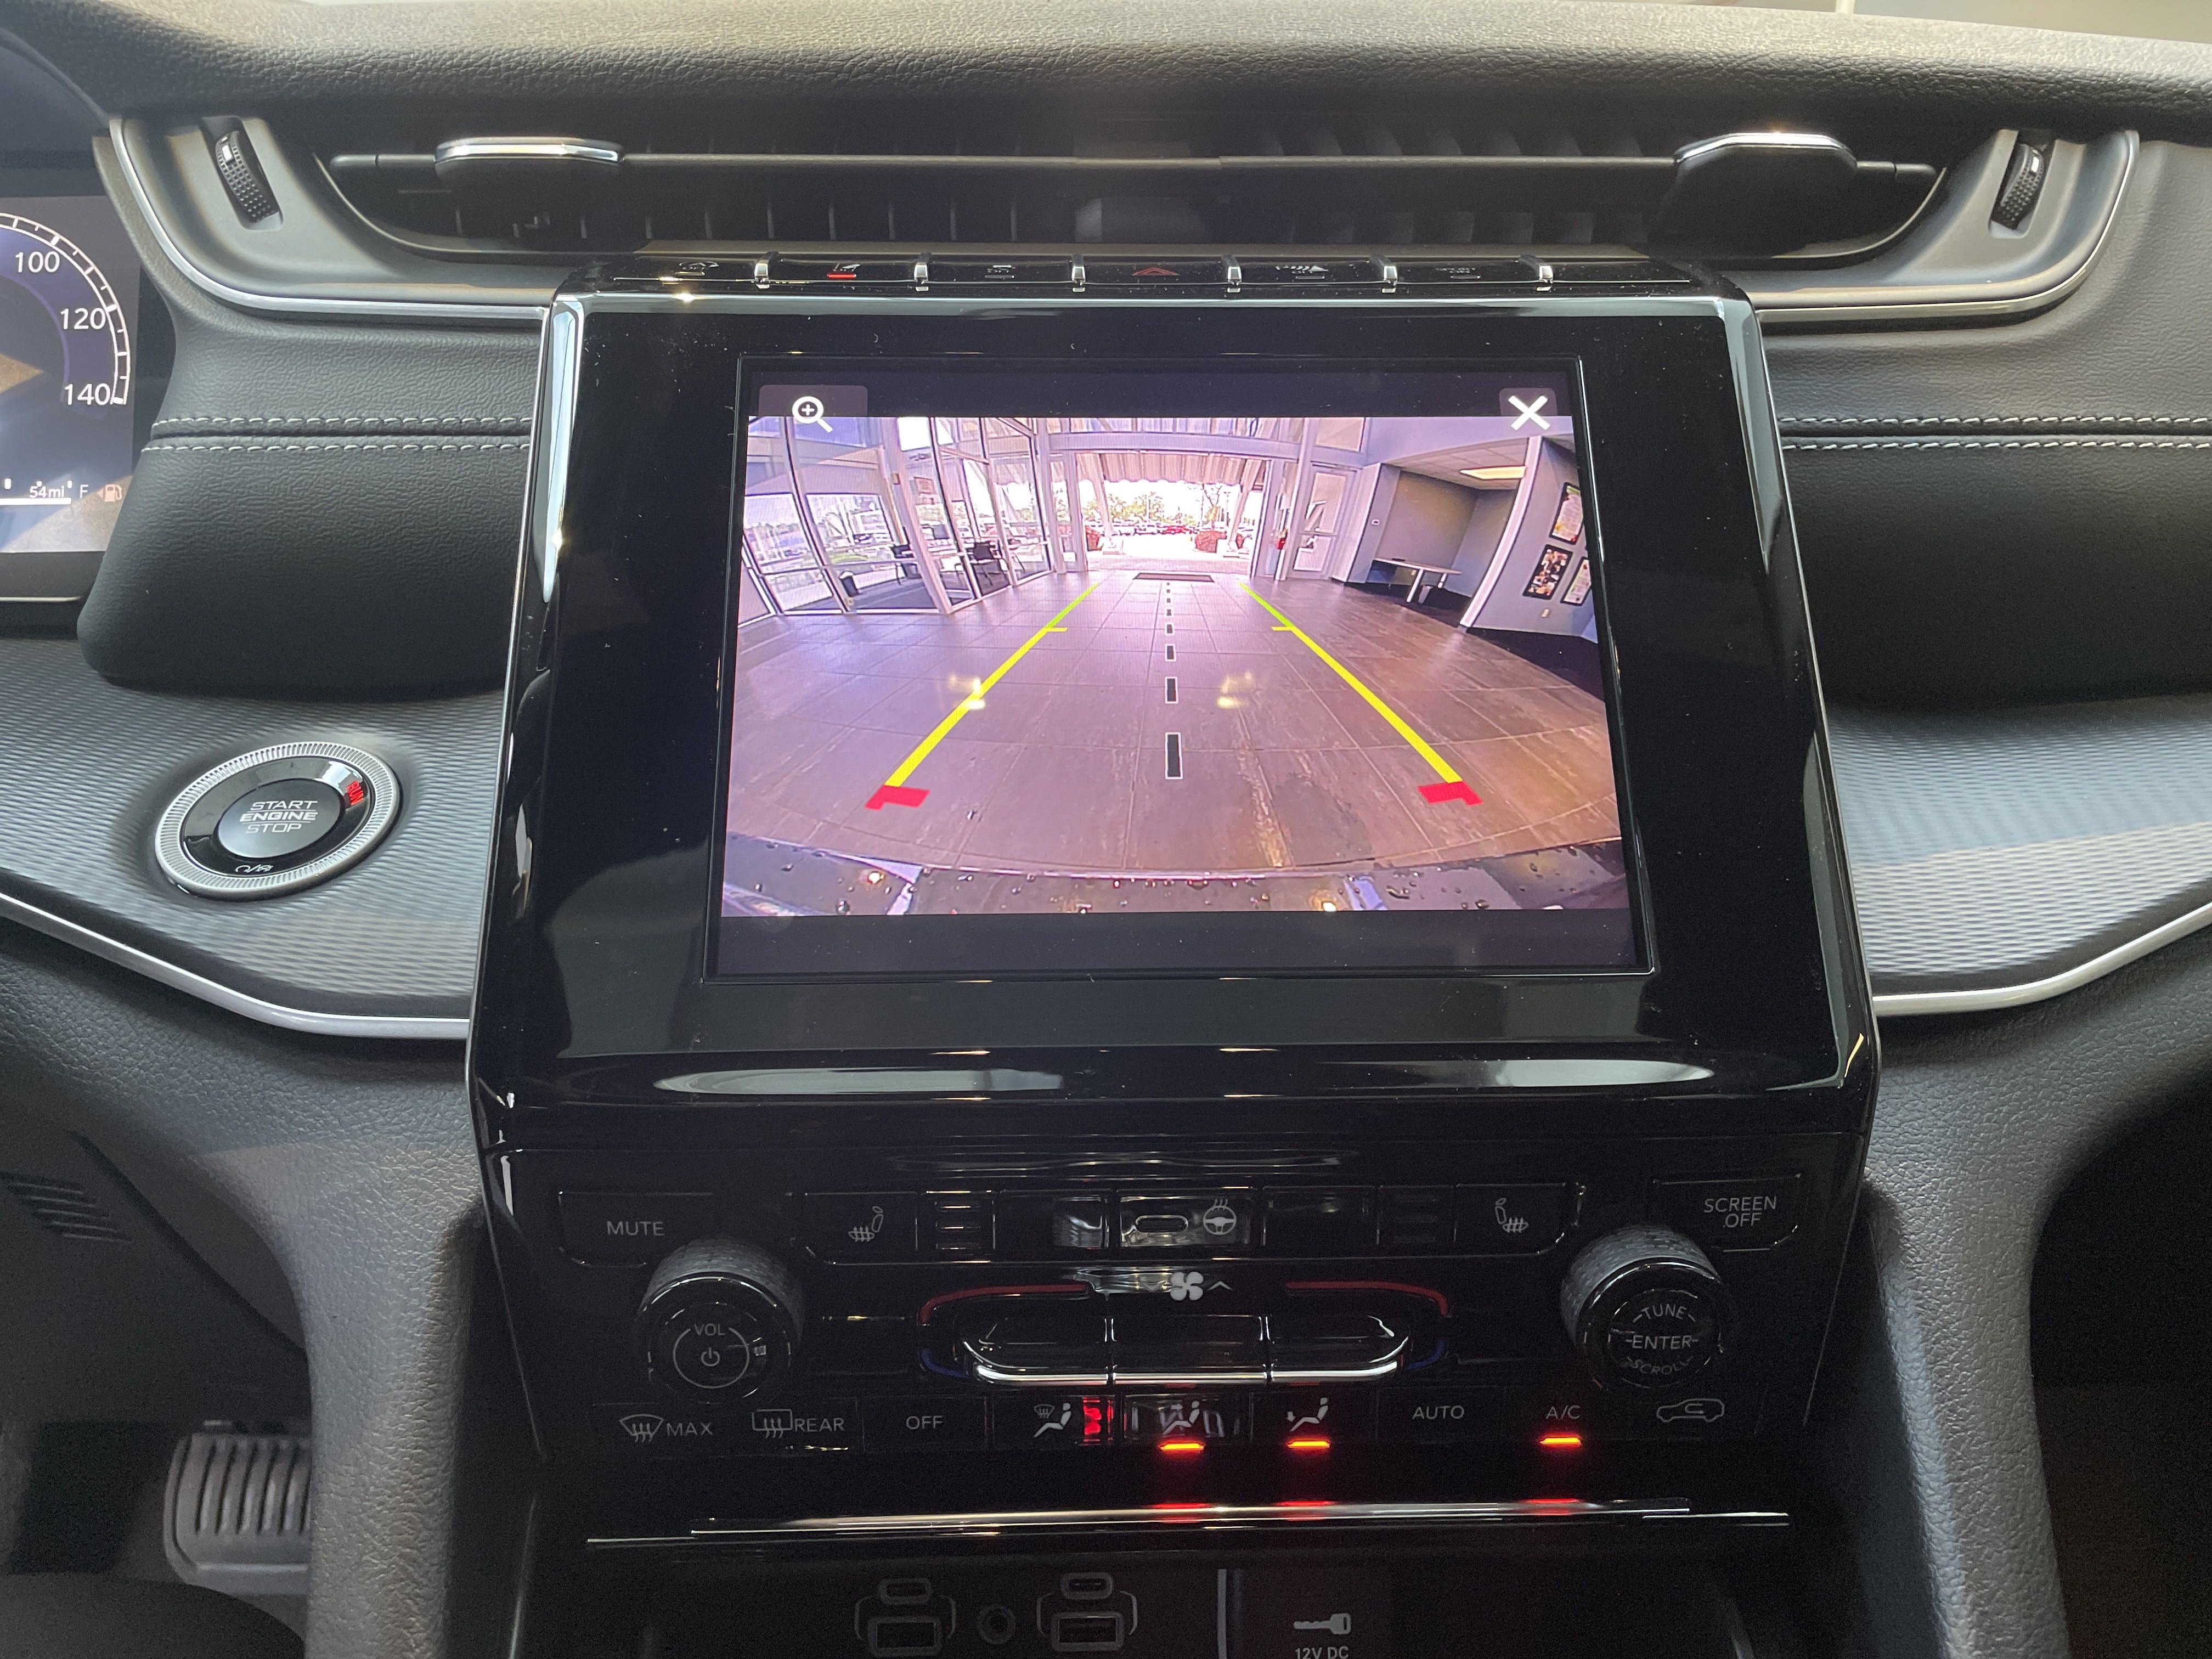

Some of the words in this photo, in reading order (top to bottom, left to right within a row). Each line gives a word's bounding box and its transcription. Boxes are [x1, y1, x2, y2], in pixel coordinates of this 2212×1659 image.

[15, 251, 60, 273] 100
[60, 308, 106, 330] 120
[64, 383, 111, 405] 140
[29, 485, 65, 498] 54mi
[80, 484, 89, 499] F
[346, 781, 364, 806] RUN
[250, 800, 318, 811] START
[239, 811, 318, 822] ENGINE
[245, 823, 302, 834] STOP
[1703, 1195, 1776, 1213] SCREEN
[1725, 1212, 1762, 1228] OFF
[607, 1221, 665, 1236] MUTE
[1640, 1303, 1687, 1320] TUNE
[694, 1323, 726, 1336] VOL
[1632, 1335, 1692, 1350] ENTER
[1630, 1359, 1689, 1375] SCROLL
[1412, 1404, 1465, 1420] AUTO
[1545, 1404, 1581, 1420] A/C
[667, 1422, 713, 1436] MAX
[794, 1418, 844, 1433] REAR
[906, 1415, 943, 1430] OFF
[1295, 1647, 1323, 1659] 12V
[1328, 1646, 1349, 1659] DC
